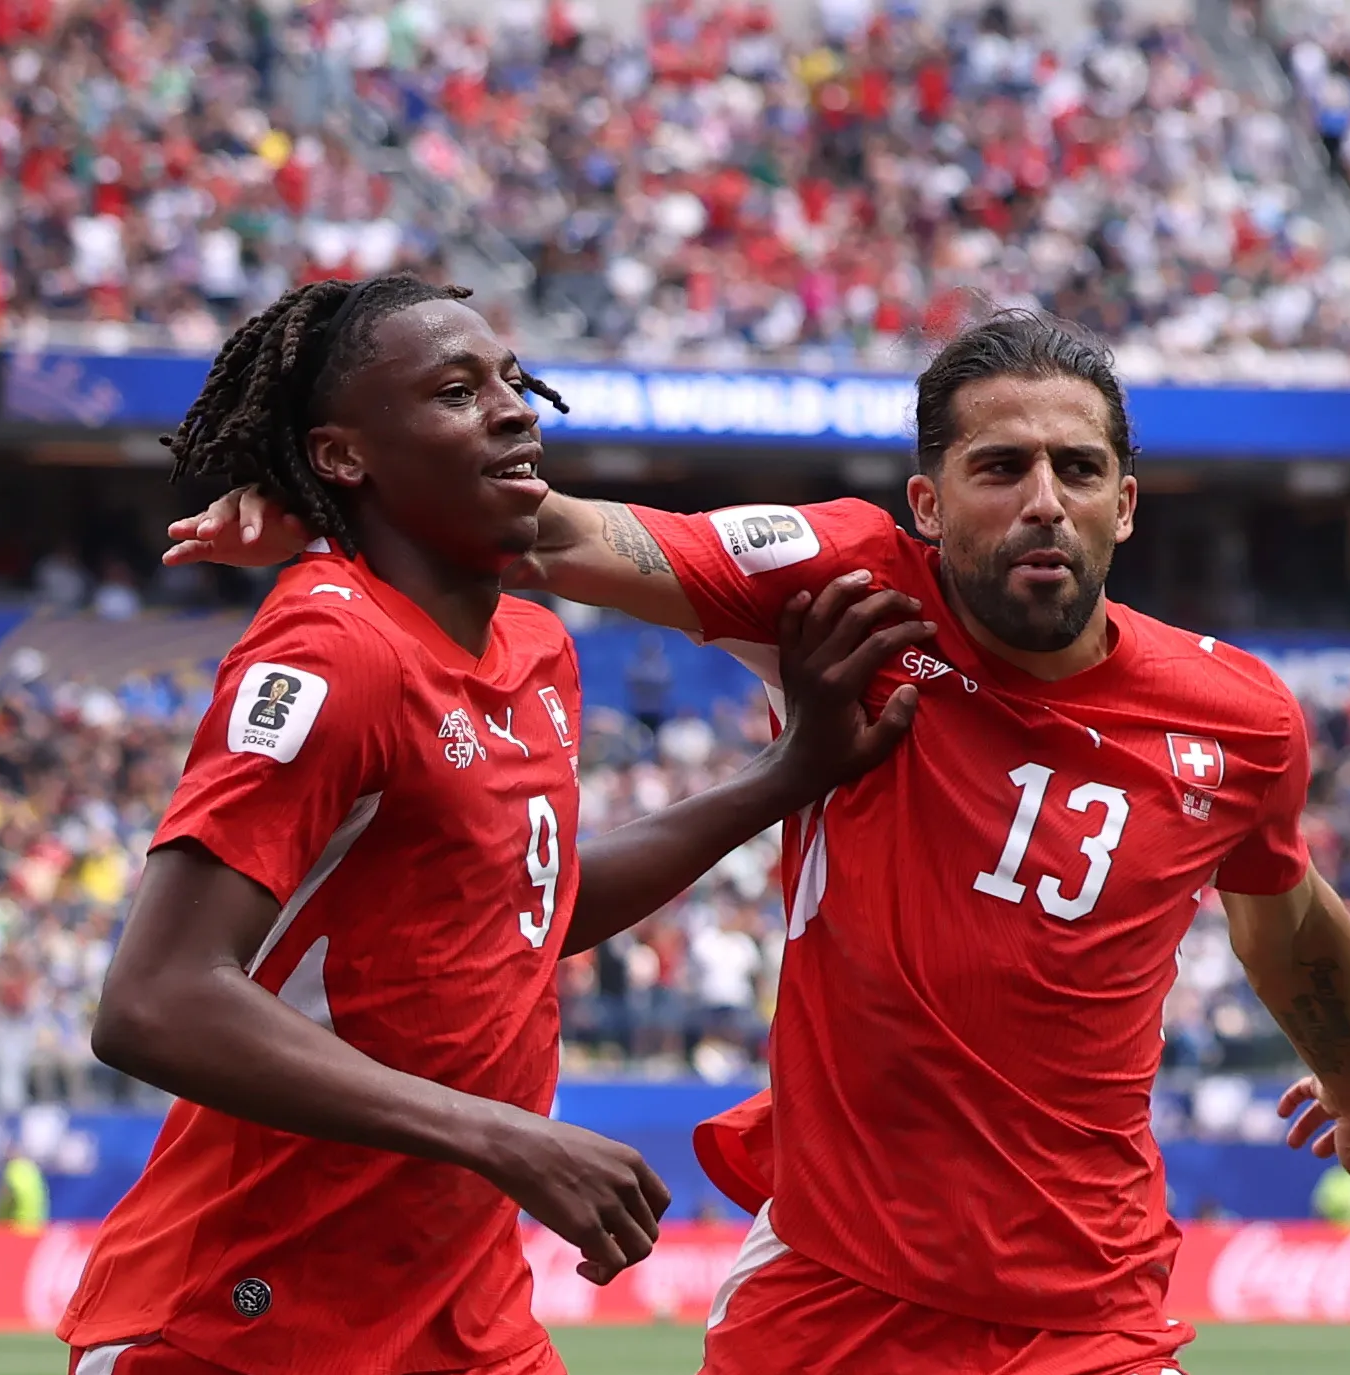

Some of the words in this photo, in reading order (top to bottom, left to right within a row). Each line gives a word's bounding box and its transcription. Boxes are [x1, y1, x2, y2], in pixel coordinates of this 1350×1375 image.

[647, 372, 828, 437] WORLD
[723, 522, 742, 556] 2026
[241, 735, 277, 748] 2026
[255, 714, 275, 726] FIFA
[973, 762, 1130, 921] 13
[519, 795, 560, 948] 9
